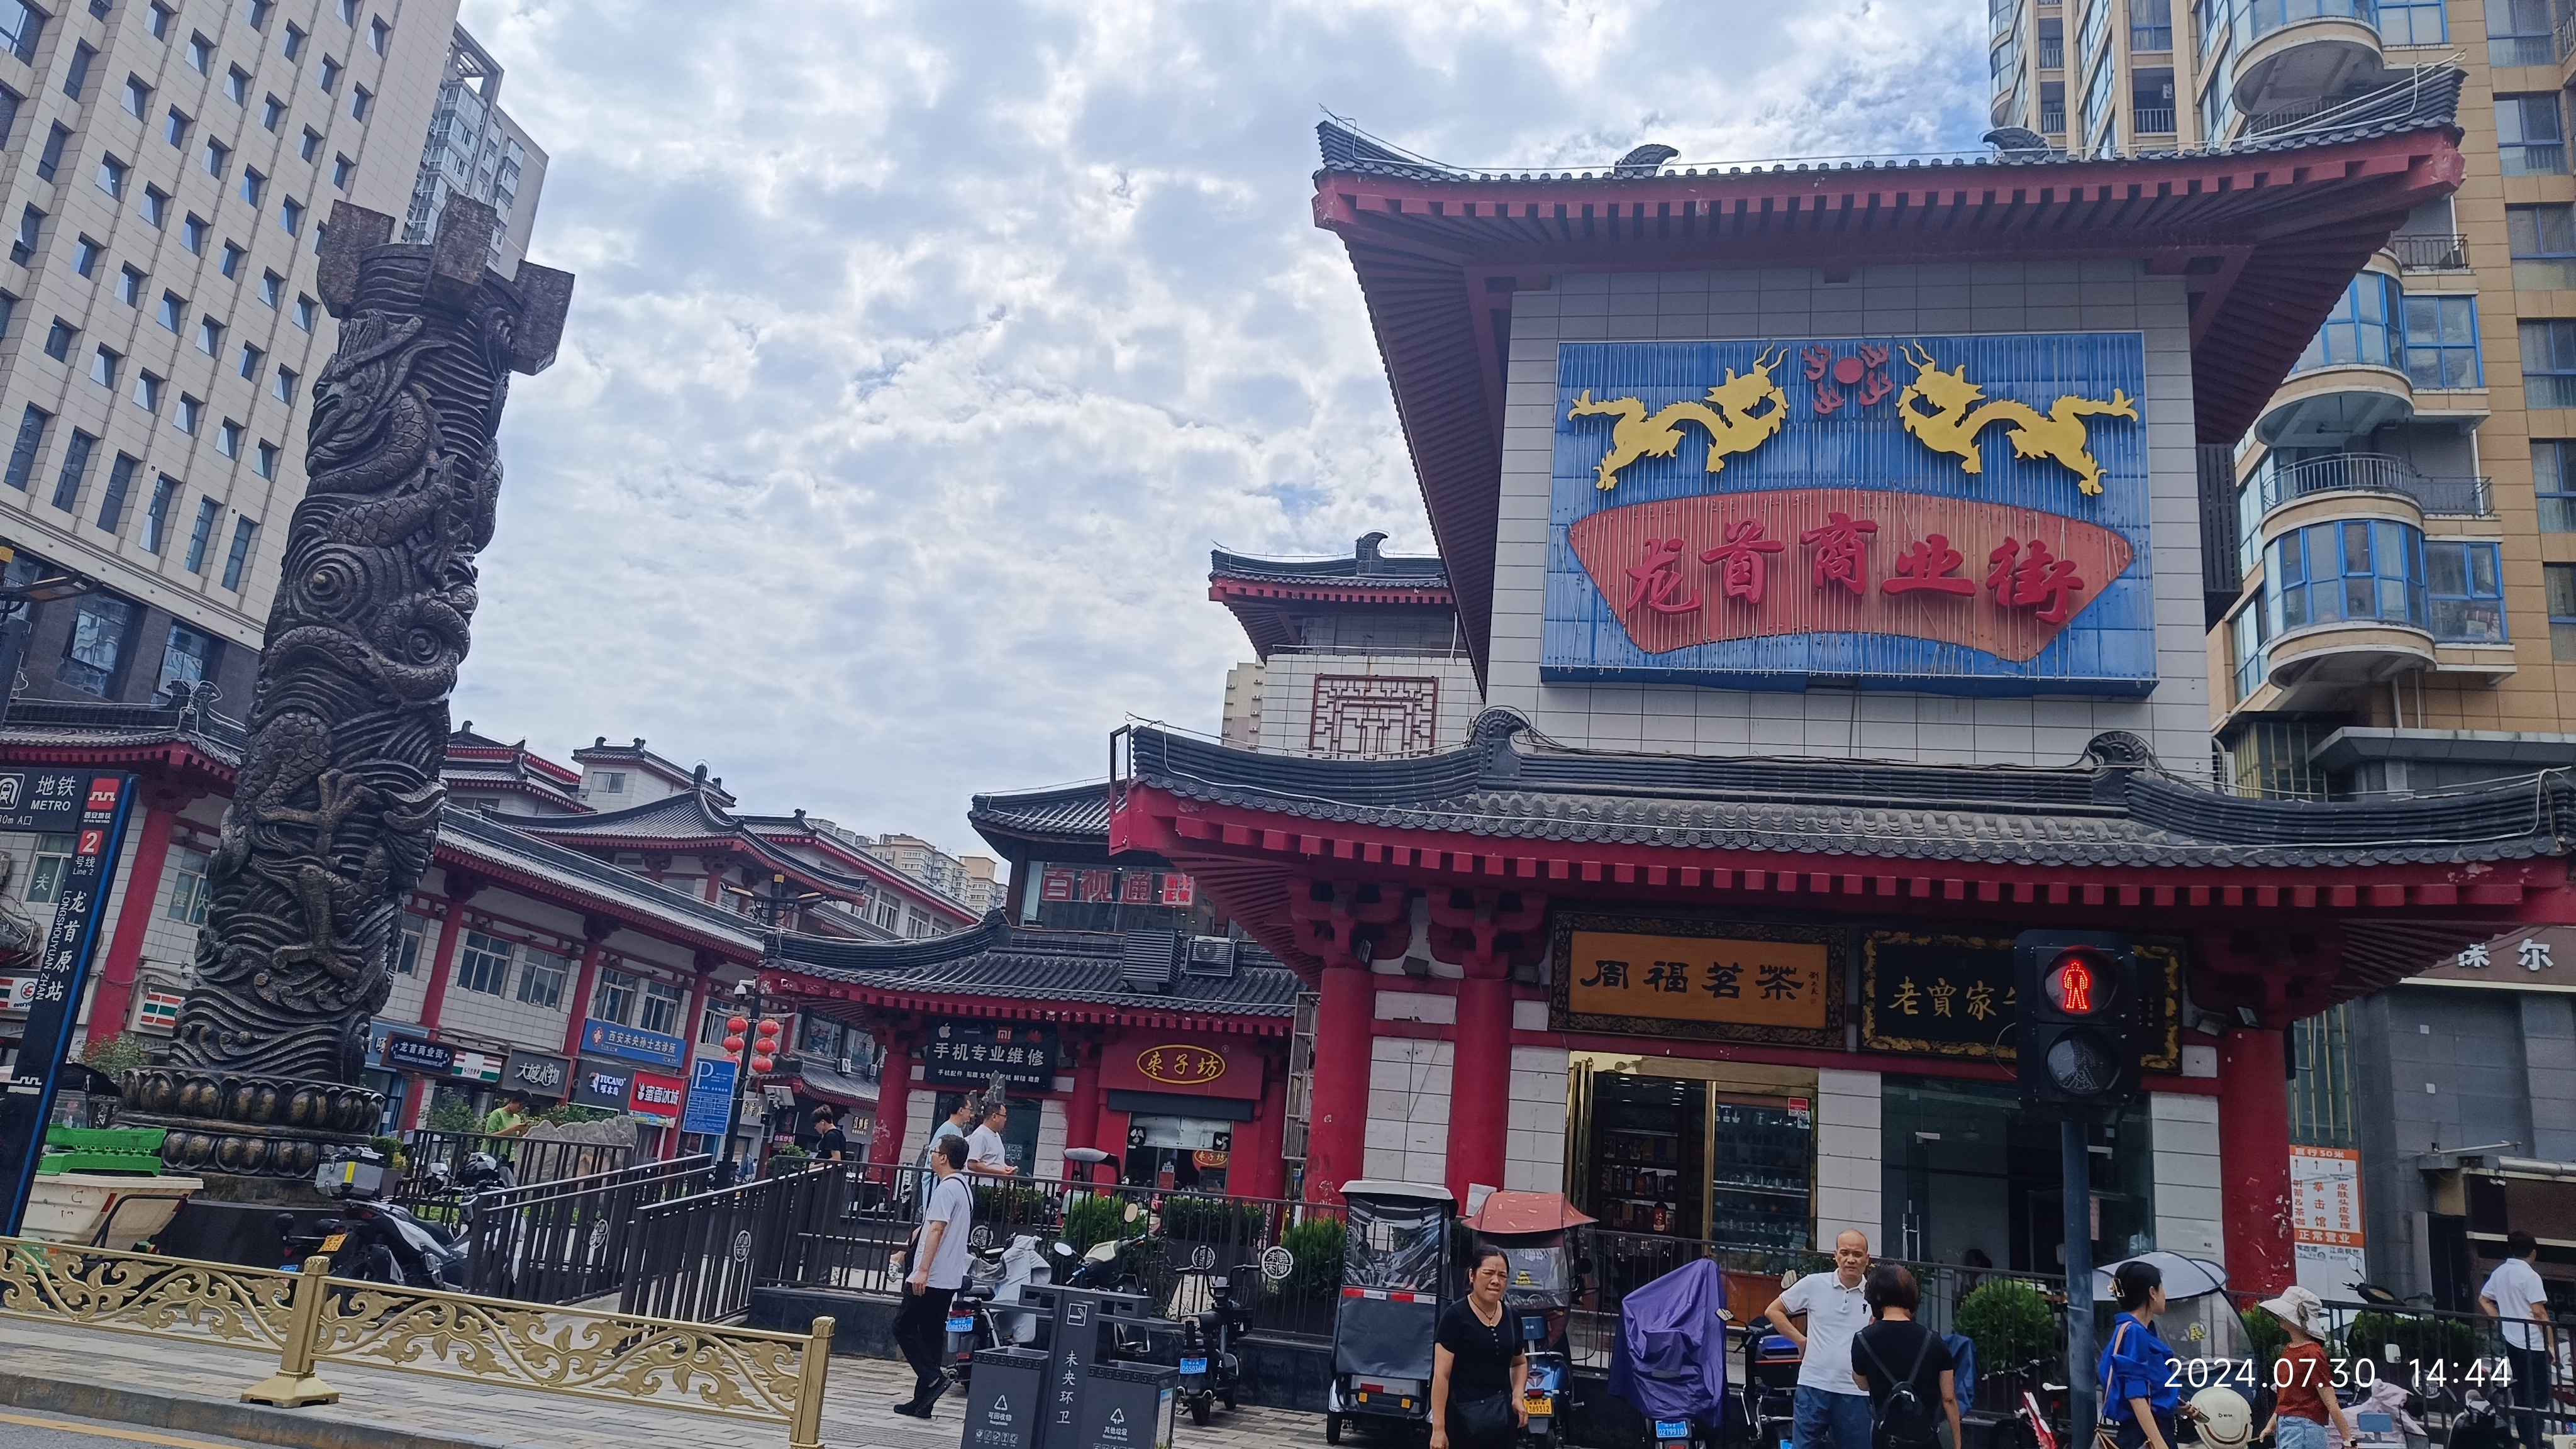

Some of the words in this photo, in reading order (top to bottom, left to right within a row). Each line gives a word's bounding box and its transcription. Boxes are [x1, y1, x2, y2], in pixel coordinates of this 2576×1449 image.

[1625, 512, 2085, 625] 龙首商业街
[36, 775, 76, 796] 地铁
[31, 800, 71, 811] METRO
[82, 832, 97, 853] 2
[75, 857, 96, 868] 号线
[1041, 868, 1154, 904] 百视通
[43, 891, 72, 969] LONGSHOUYUAN
[45, 891, 86, 1002] 龙首原站
[35, 973, 50, 1000] ZHAN
[1580, 960, 1804, 1001] 周福茗茶
[399, 1041, 445, 1059] 龙首商业街
[609, 1030, 676, 1054] 西安未央孙士杰诊所
[934, 1043, 1044, 1067] 手机专业维修
[1146, 1051, 1218, 1077] 枣子坊
[600, 1074, 625, 1087] TUCANO
[692, 1061, 714, 1089] P
[600, 1084, 619, 1096] 啄木鸟
[645, 1085, 680, 1106] 蜜雪冰城
[2313, 1182, 2326, 1227] 拳击馆
[2298, 1230, 2351, 1244] 正常营业
[1057, 1350, 1079, 1424] 未央环卫
[988, 1411, 1012, 1421] 可回收物
[1104, 1426, 1128, 1436] 其他垃圾
